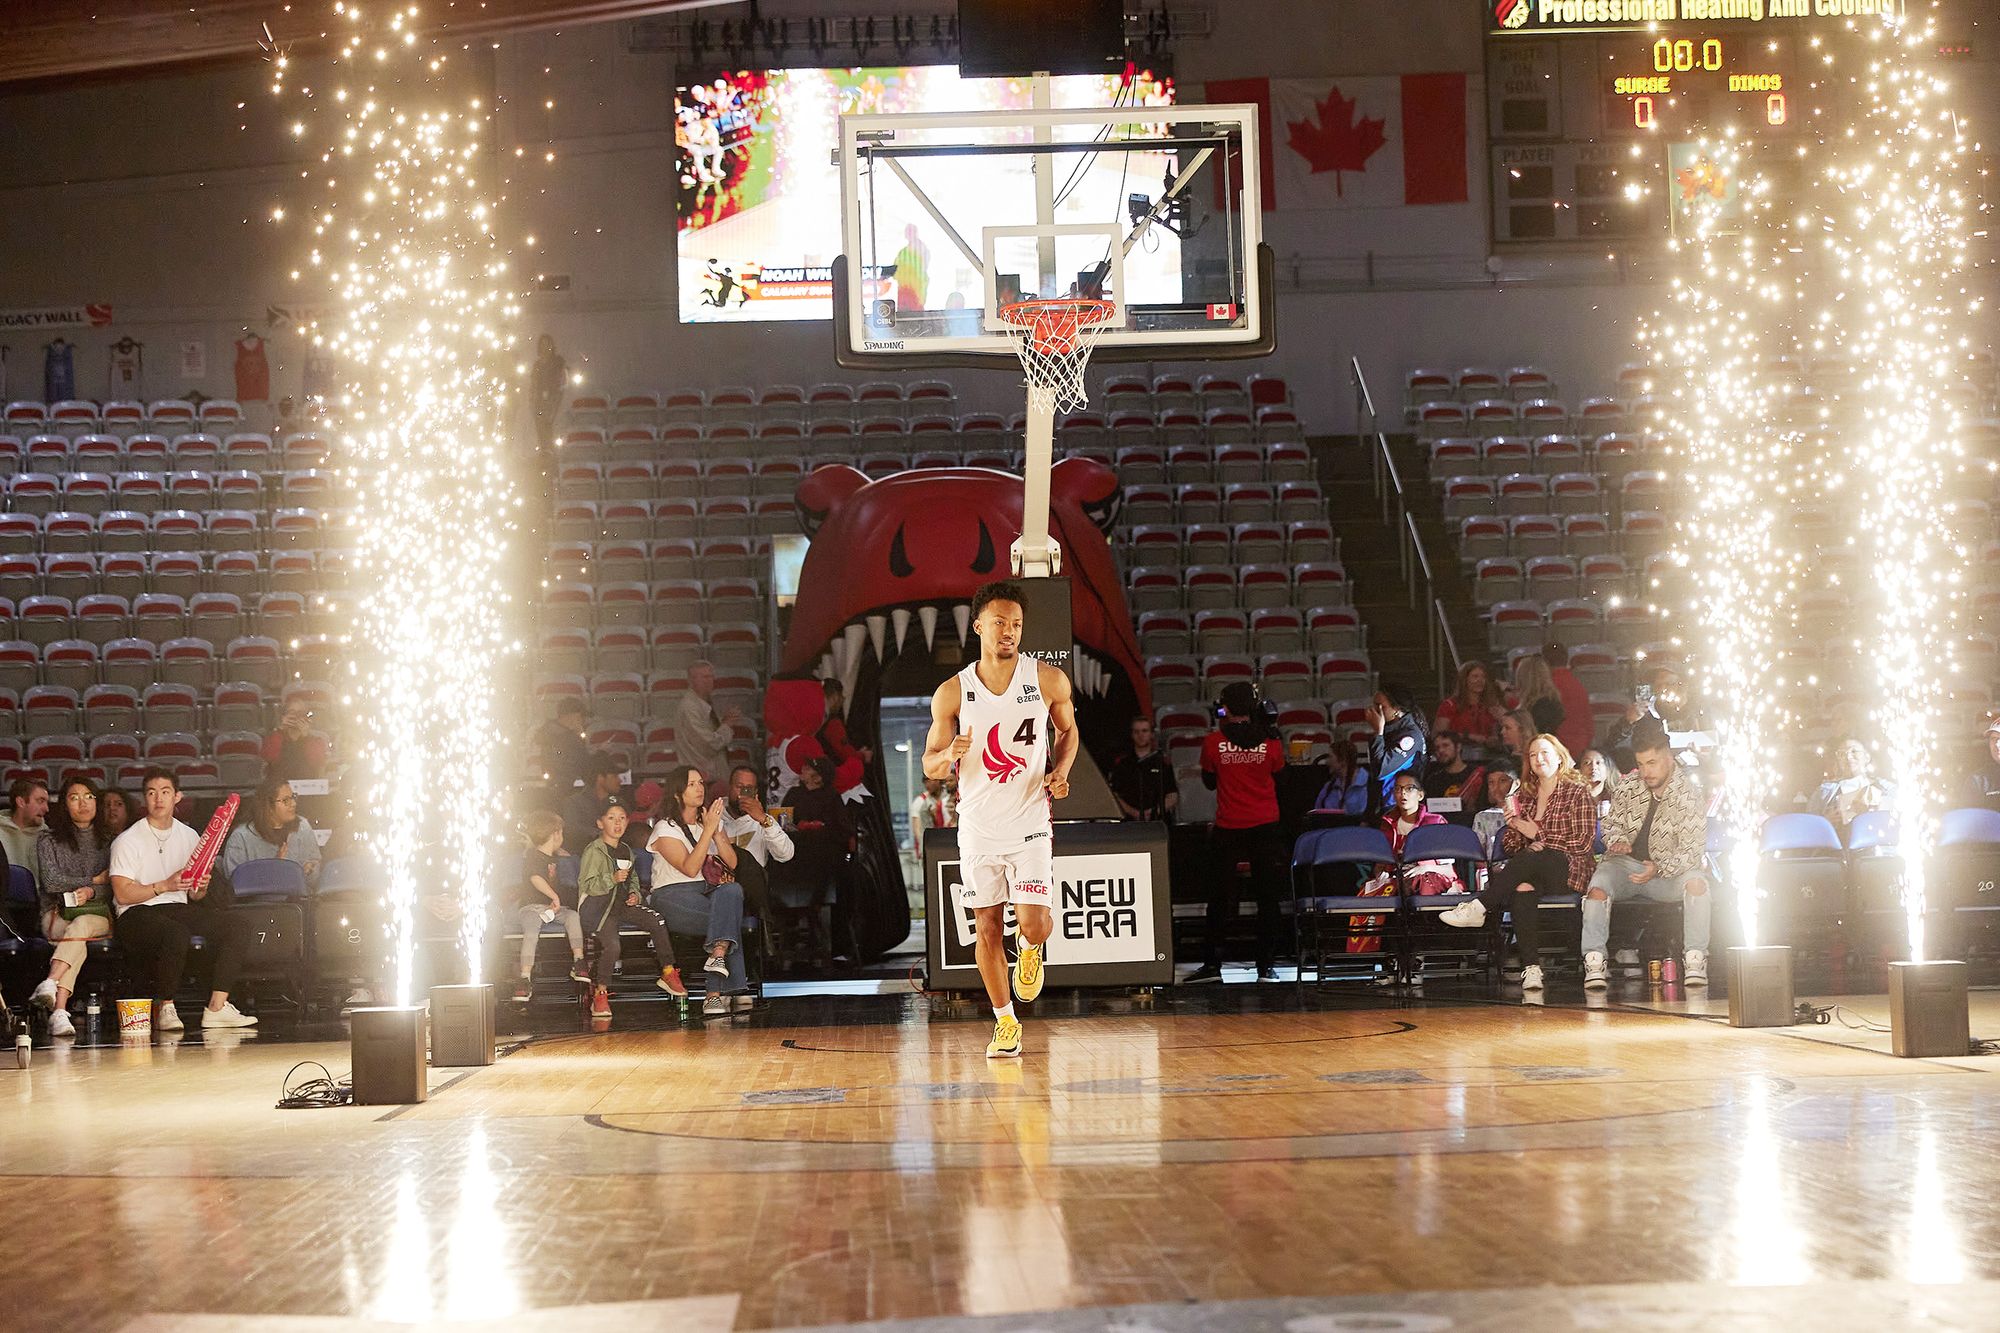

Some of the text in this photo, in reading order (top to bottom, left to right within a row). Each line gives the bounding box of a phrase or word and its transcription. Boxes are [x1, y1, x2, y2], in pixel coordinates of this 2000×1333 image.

[1539, 0, 1676, 24] Professional
[1681, 0, 1764, 21] Heating
[1768, 0, 1809, 18] And
[1653, 38, 1722, 73] 00.0
[1614, 76, 1671, 95] SURGE
[1634, 96, 1653, 129] 0
[760, 269, 804, 282] NOAH
[45, 311, 82, 323] WALL
[863, 341, 904, 350] SPALDING
[1012, 717, 1037, 747] 4
[1220, 752, 1266, 765] STAFF
[1061, 878, 1136, 909] NEW
[1977, 881, 1994, 892] 20
[1062, 908, 1137, 940] ERA
[257, 932, 266, 944] 7
[348, 928, 361, 944] 8
